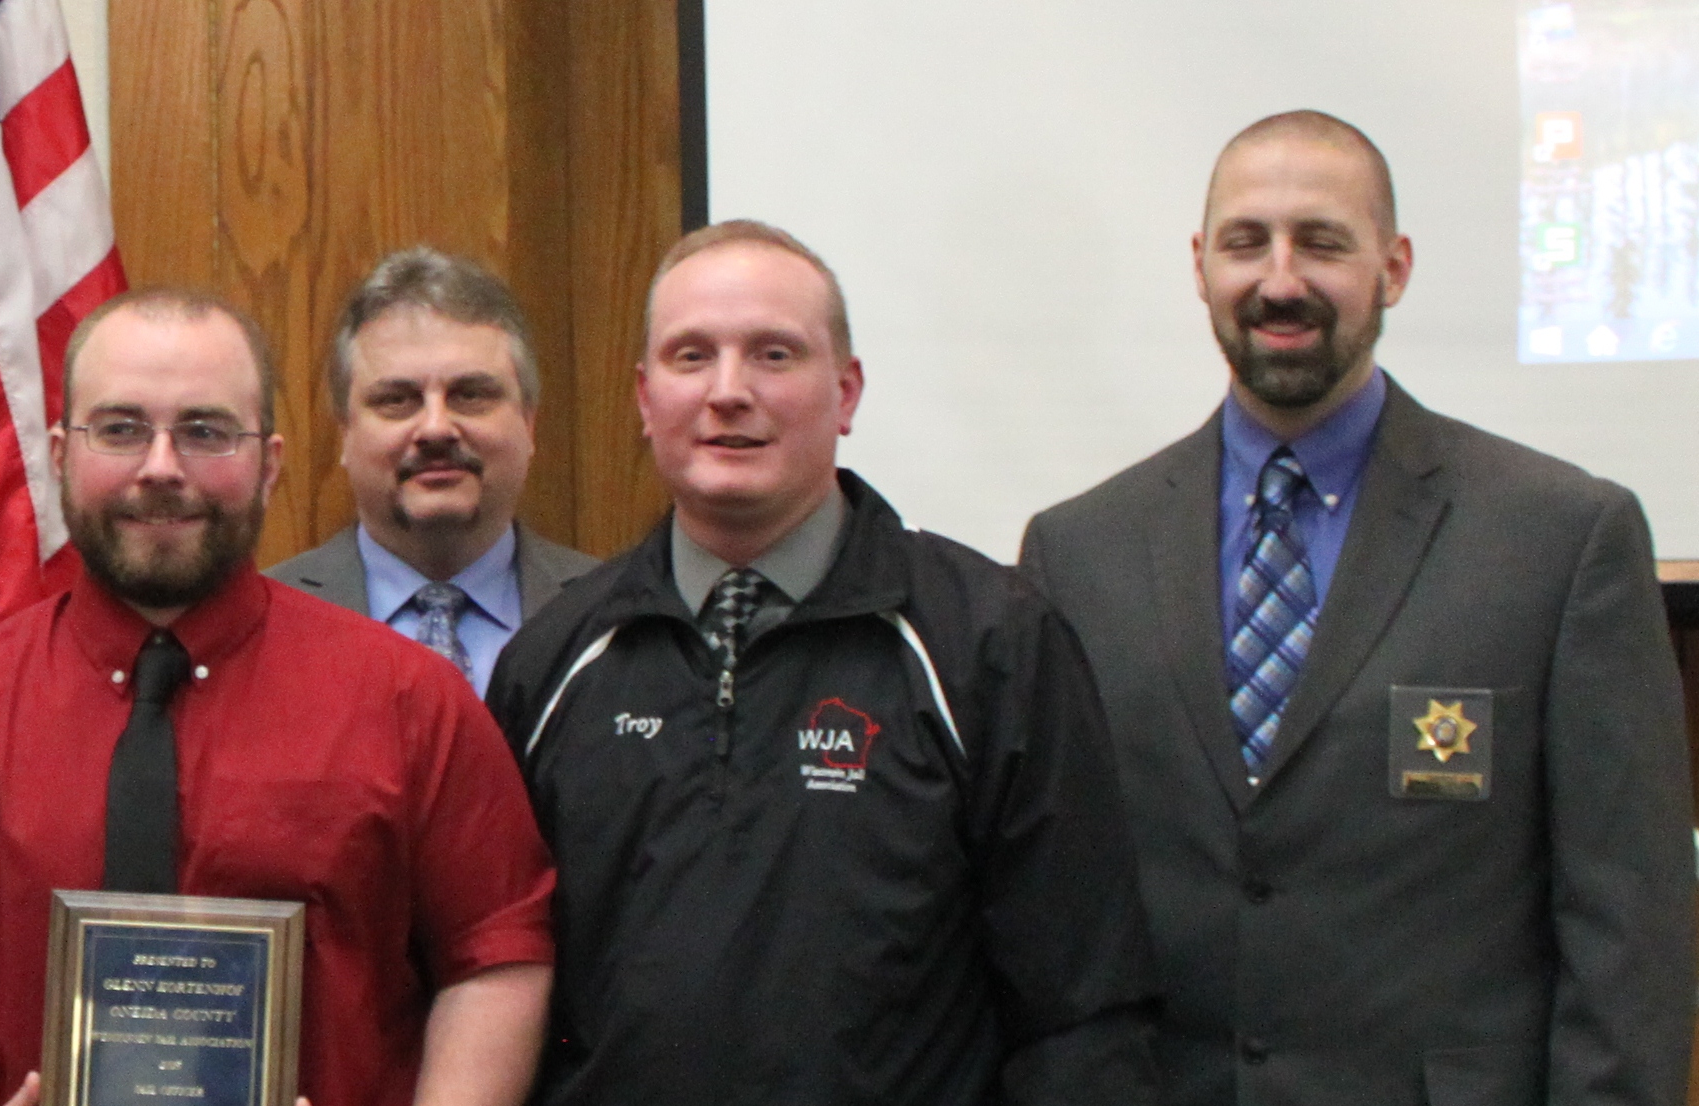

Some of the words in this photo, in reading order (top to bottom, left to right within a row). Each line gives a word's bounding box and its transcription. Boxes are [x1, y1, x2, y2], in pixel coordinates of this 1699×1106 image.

[614, 711, 663, 739] Troy
[798, 729, 855, 752] WJA
[200, 957, 216, 968] TO
[109, 1006, 167, 1020] ONEIDA
[173, 1008, 237, 1023] COUNTY
